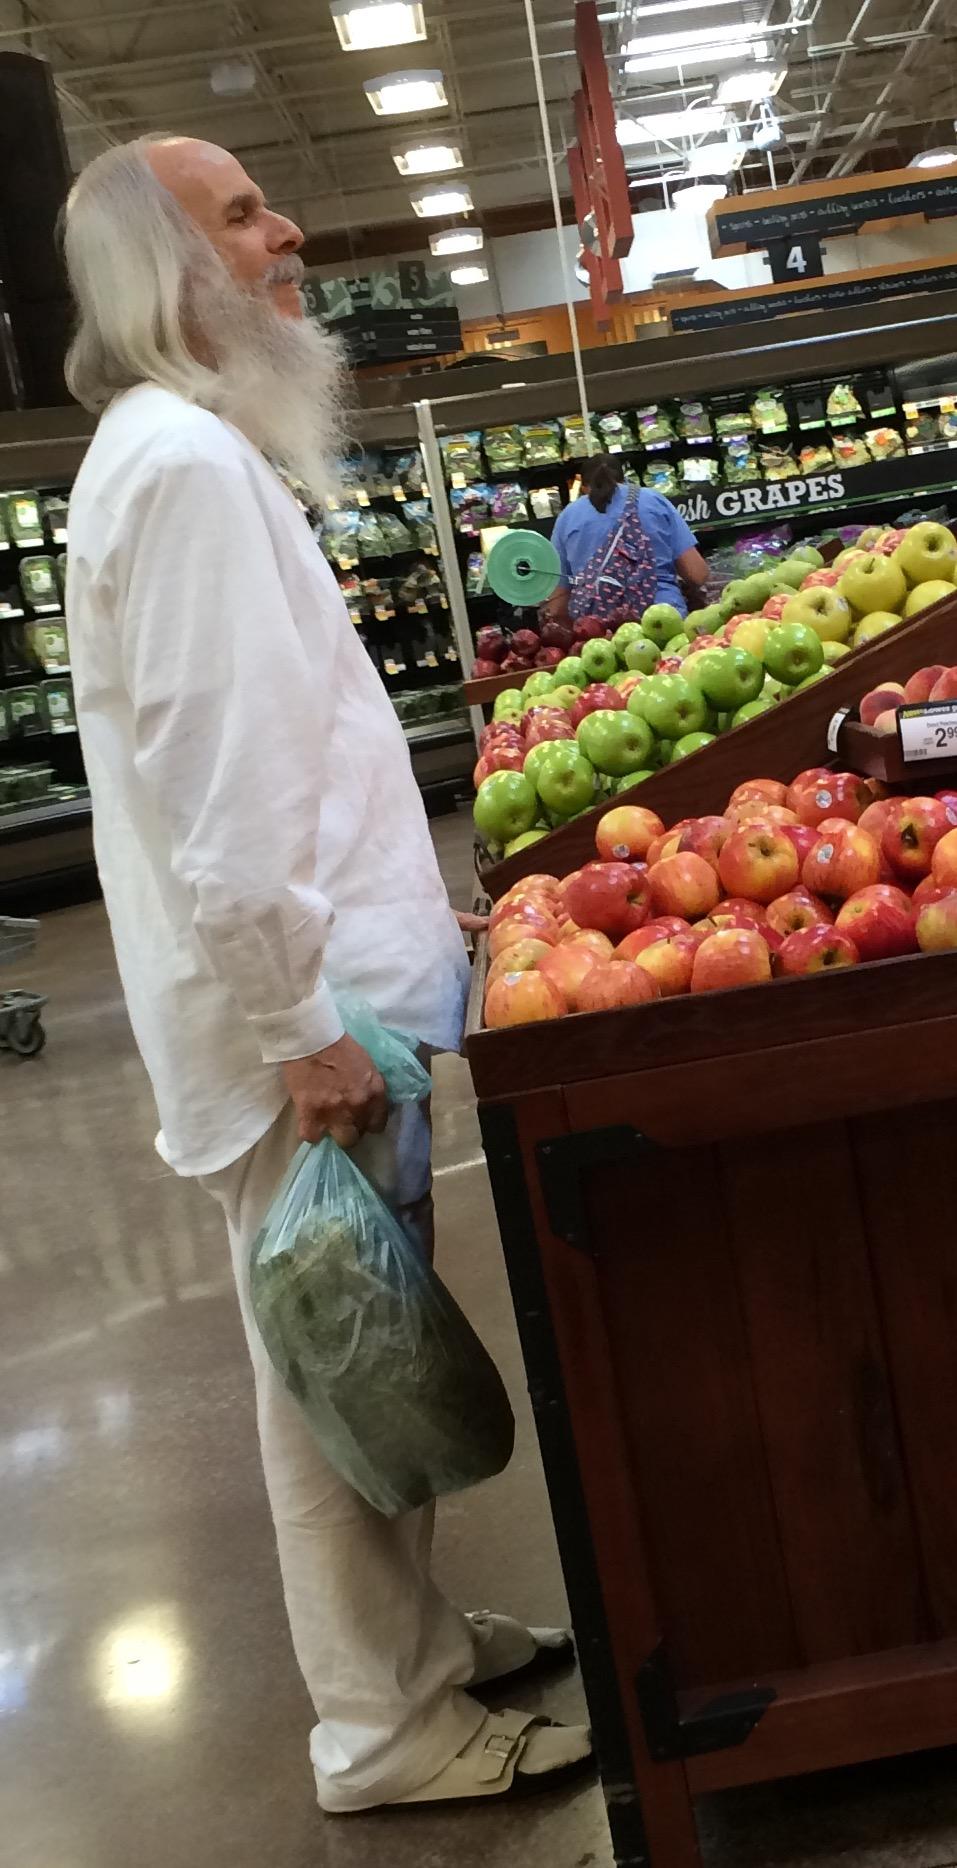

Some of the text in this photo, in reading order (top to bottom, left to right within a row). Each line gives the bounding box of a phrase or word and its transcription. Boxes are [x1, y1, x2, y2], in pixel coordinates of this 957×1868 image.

[786, 246, 807, 273] 4
[676, 473, 845, 522] esh GRAPES
